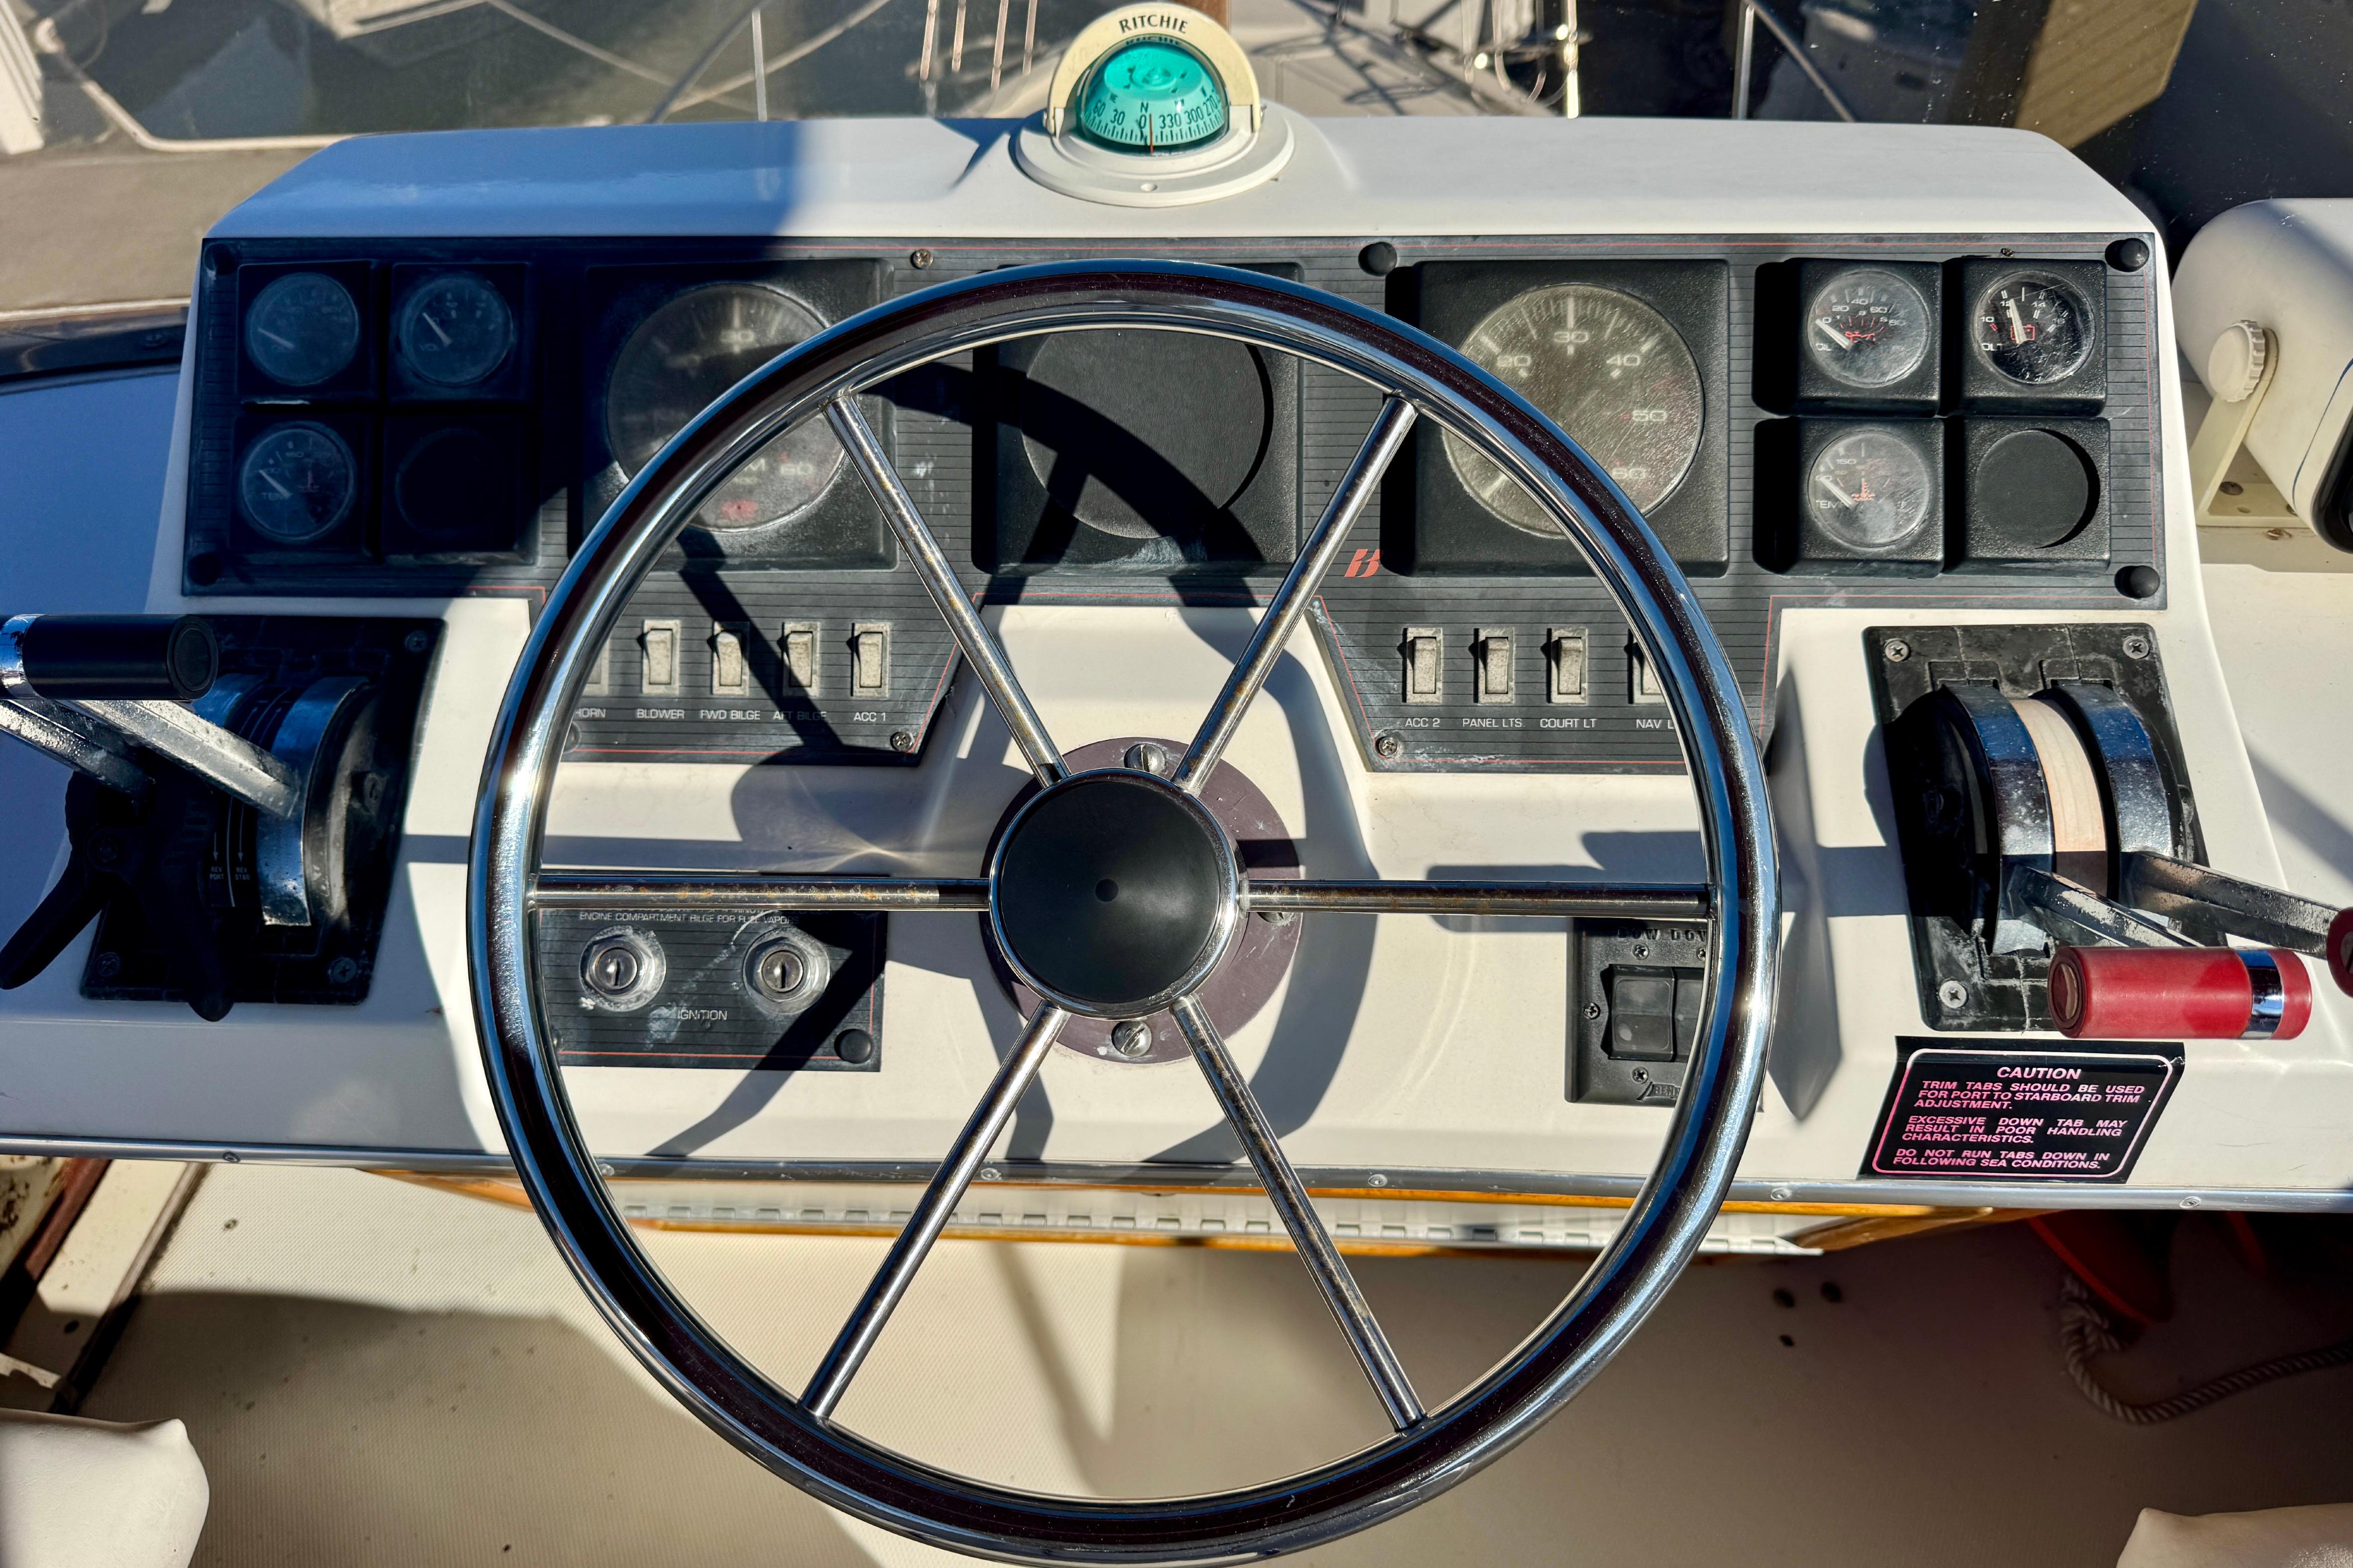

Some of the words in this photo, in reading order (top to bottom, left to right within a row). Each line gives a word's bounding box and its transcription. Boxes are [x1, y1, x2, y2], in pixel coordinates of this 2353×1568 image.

[1119, 14, 1188, 34] RITCHIE
[1093, 99, 1106, 117] 60
[1110, 109, 1125, 125] 30
[1138, 114, 1147, 129] 0
[1159, 113, 1182, 129] 330
[1184, 106, 1203, 124] 300
[1203, 95, 1218, 117] 270
[1140, 102, 1148, 113] N
[1553, 331, 1589, 343] 30
[1606, 355, 1640, 366] 40
[636, 708, 685, 719] BLOWER
[700, 709, 727, 720] FWD
[730, 710, 761, 720] BILGE
[772, 710, 793, 720] AFT
[797, 711, 827, 721] BILGE
[853, 712, 877, 722] ACC
[881, 712, 887, 721] 1
[1405, 718, 1428, 727] ACC
[1432, 718, 1440, 727] 2
[1462, 718, 1499, 727] PANEL
[1502, 718, 1525, 728] LTS.
[1540, 718, 1580, 728] COURT
[1583, 718, 1598, 728] LT
[1636, 719, 1663, 729] NAV
[579, 911, 613, 921] ENGINE
[615, 912, 686, 922] COMPARTMENT
[690, 914, 714, 923] BILGE
[678, 1009, 727, 1020] IGNITION
[1997, 1067, 2081, 1079] CAUTION
[1923, 1080, 1957, 1089] TRIM
[1966, 1081, 2003, 1090] TABS
[2010, 1083, 2070, 1092] SHOULD
[2077, 1084, 2099, 1093] BE
[2105, 1085, 2145, 1094] USED
[1918, 1090, 1948, 1098] FOR
[1951, 1091, 1990, 1099] PORT
[2014, 1092, 2102, 1102] STARBOARD
[2105, 1094, 2141, 1103] TRIM
[1914, 1099, 2013, 1109] ADJUSTMENT.
[1908, 1115, 1987, 1125] EXCESSIVE
[1998, 1118, 2044, 1126] DOWN
[2056, 1119, 2083, 1127] TAB
[1905, 1124, 1959, 1133] RESULT
[1995, 1126, 2036, 1135] POOR
[2046, 1127, 2122, 1137] HANDLING
[1902, 1133, 2034, 1143] CHARACTERISTICS.
[2042, 1152, 2087, 1161] DOWN
[1893, 1157, 1976, 1166] FOLLOWING
[2011, 1160, 2101, 1169] CONDITIONS.
